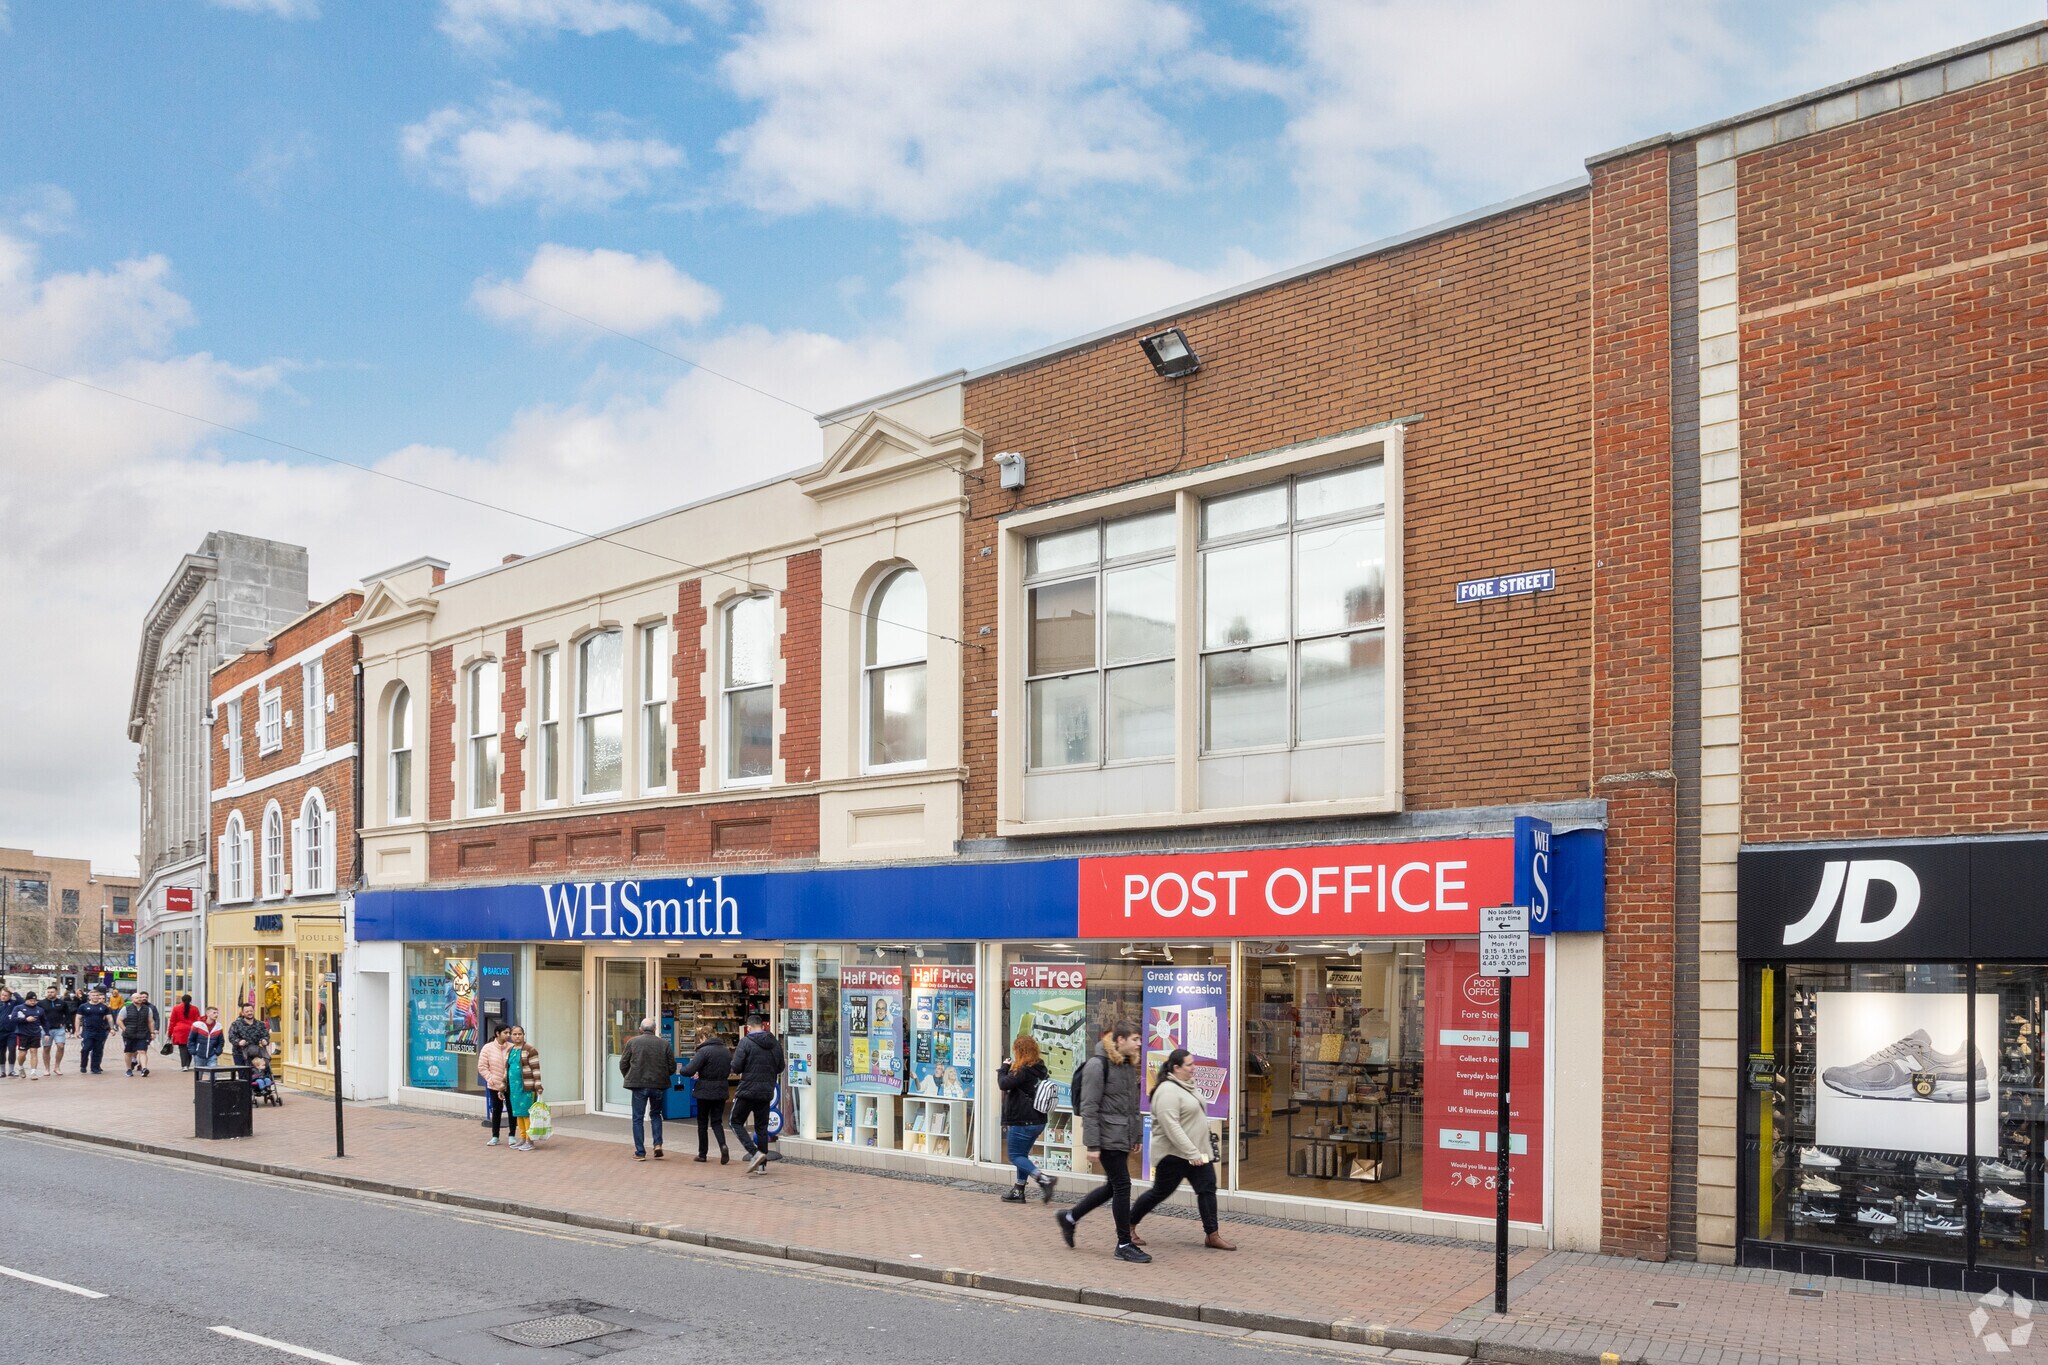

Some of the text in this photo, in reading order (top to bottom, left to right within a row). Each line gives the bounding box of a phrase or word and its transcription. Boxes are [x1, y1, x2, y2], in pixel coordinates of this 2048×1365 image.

[1461, 573, 1551, 598] FORE STREET
[1531, 830, 1549, 853] WH
[1124, 861, 1468, 917] POST OFFICE
[1531, 852, 1549, 923] S
[541, 876, 742, 938] WHSmith
[1783, 859, 1921, 945] JD
[301, 934, 340, 942] JOULES
[488, 967, 510, 975] BARCLAYS
[913, 968, 974, 984] Half Price
[1012, 966, 1034, 976] Buy 1
[843, 971, 901, 985] Half Price
[1035, 966, 1083, 988] Free
[1147, 971, 1223, 982] Great cards for
[419, 978, 446, 987] NEW
[1013, 978, 1034, 987] Get 1
[1473, 979, 1496, 987] POST
[1147, 984, 1223, 995] every occasion
[1468, 988, 1499, 996] OFFICE
[1461, 1010, 1499, 1019] Fore Stre
[1463, 1034, 1480, 1042] Open
[1488, 1035, 1499, 1043] day
[425, 1039, 442, 1051] juice
[452, 1043, 461, 1051] THIS
[461, 1044, 475, 1053] STORE
[1456, 1072, 1484, 1080] Everyday
[1465, 1107, 1498, 1115] Internation
